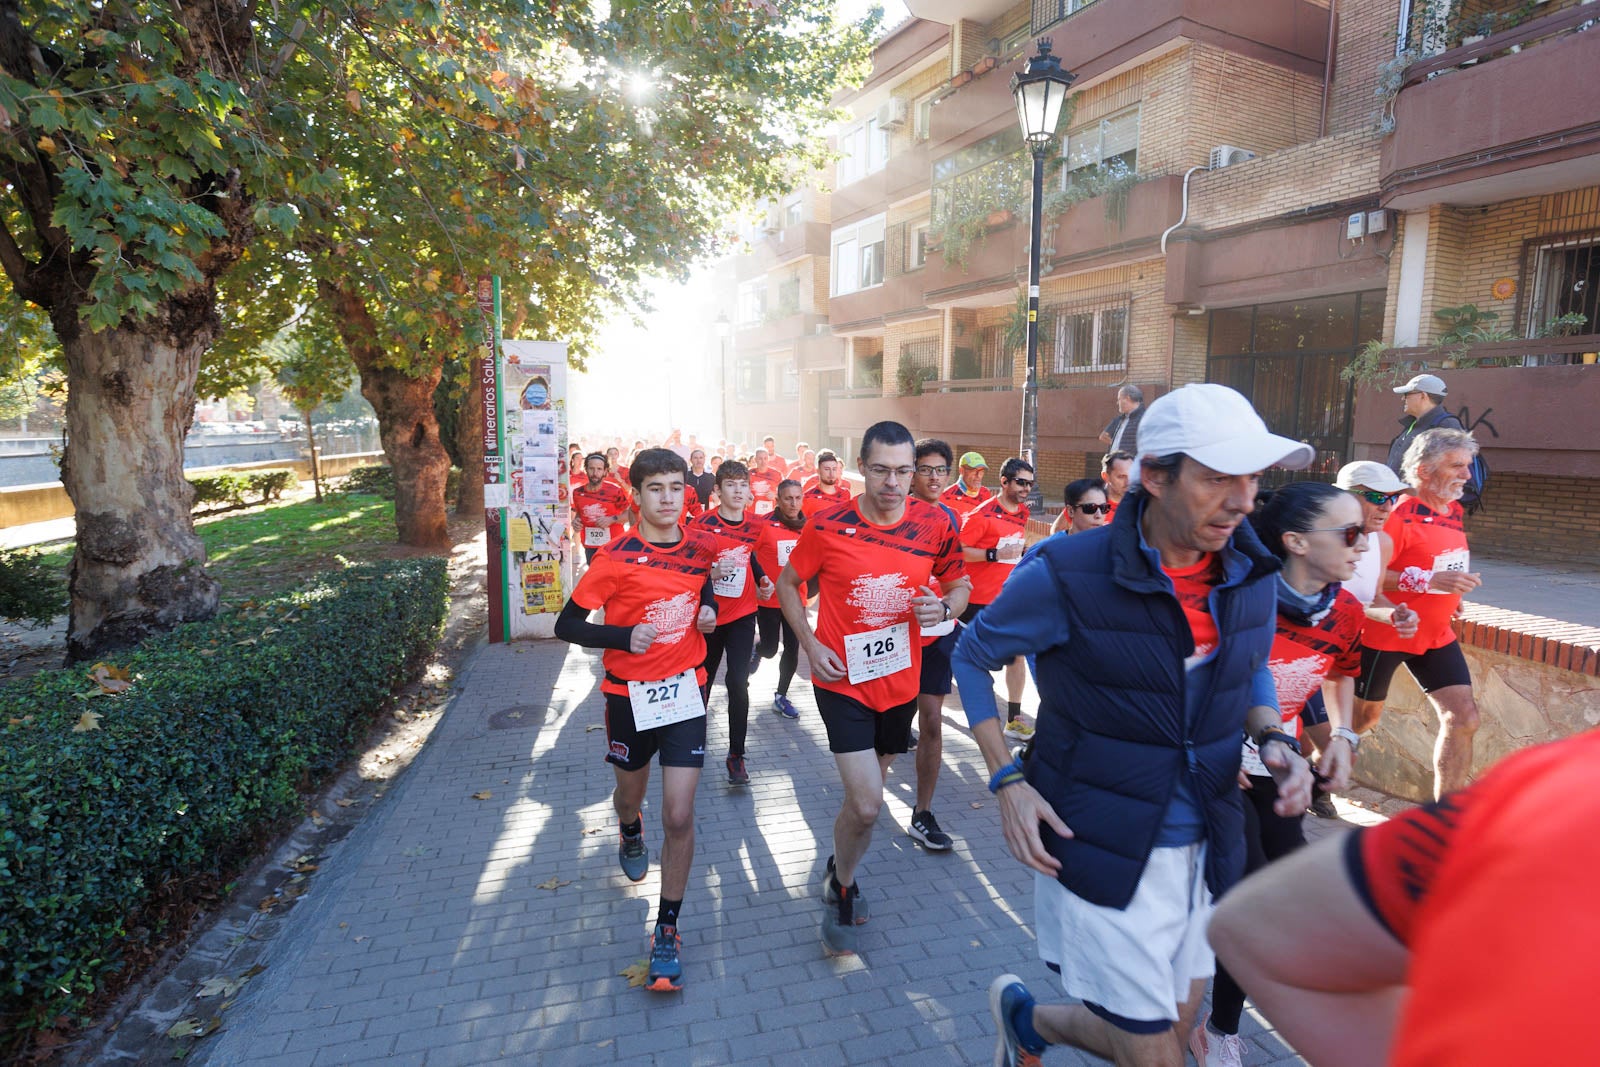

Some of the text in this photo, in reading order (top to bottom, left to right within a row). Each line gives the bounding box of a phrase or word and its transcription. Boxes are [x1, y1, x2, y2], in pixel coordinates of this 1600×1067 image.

[1297, 335, 1304, 347] 2
[853, 587, 910, 600] Carrera
[863, 637, 895, 657] 126
[646, 683, 679, 704] 227
